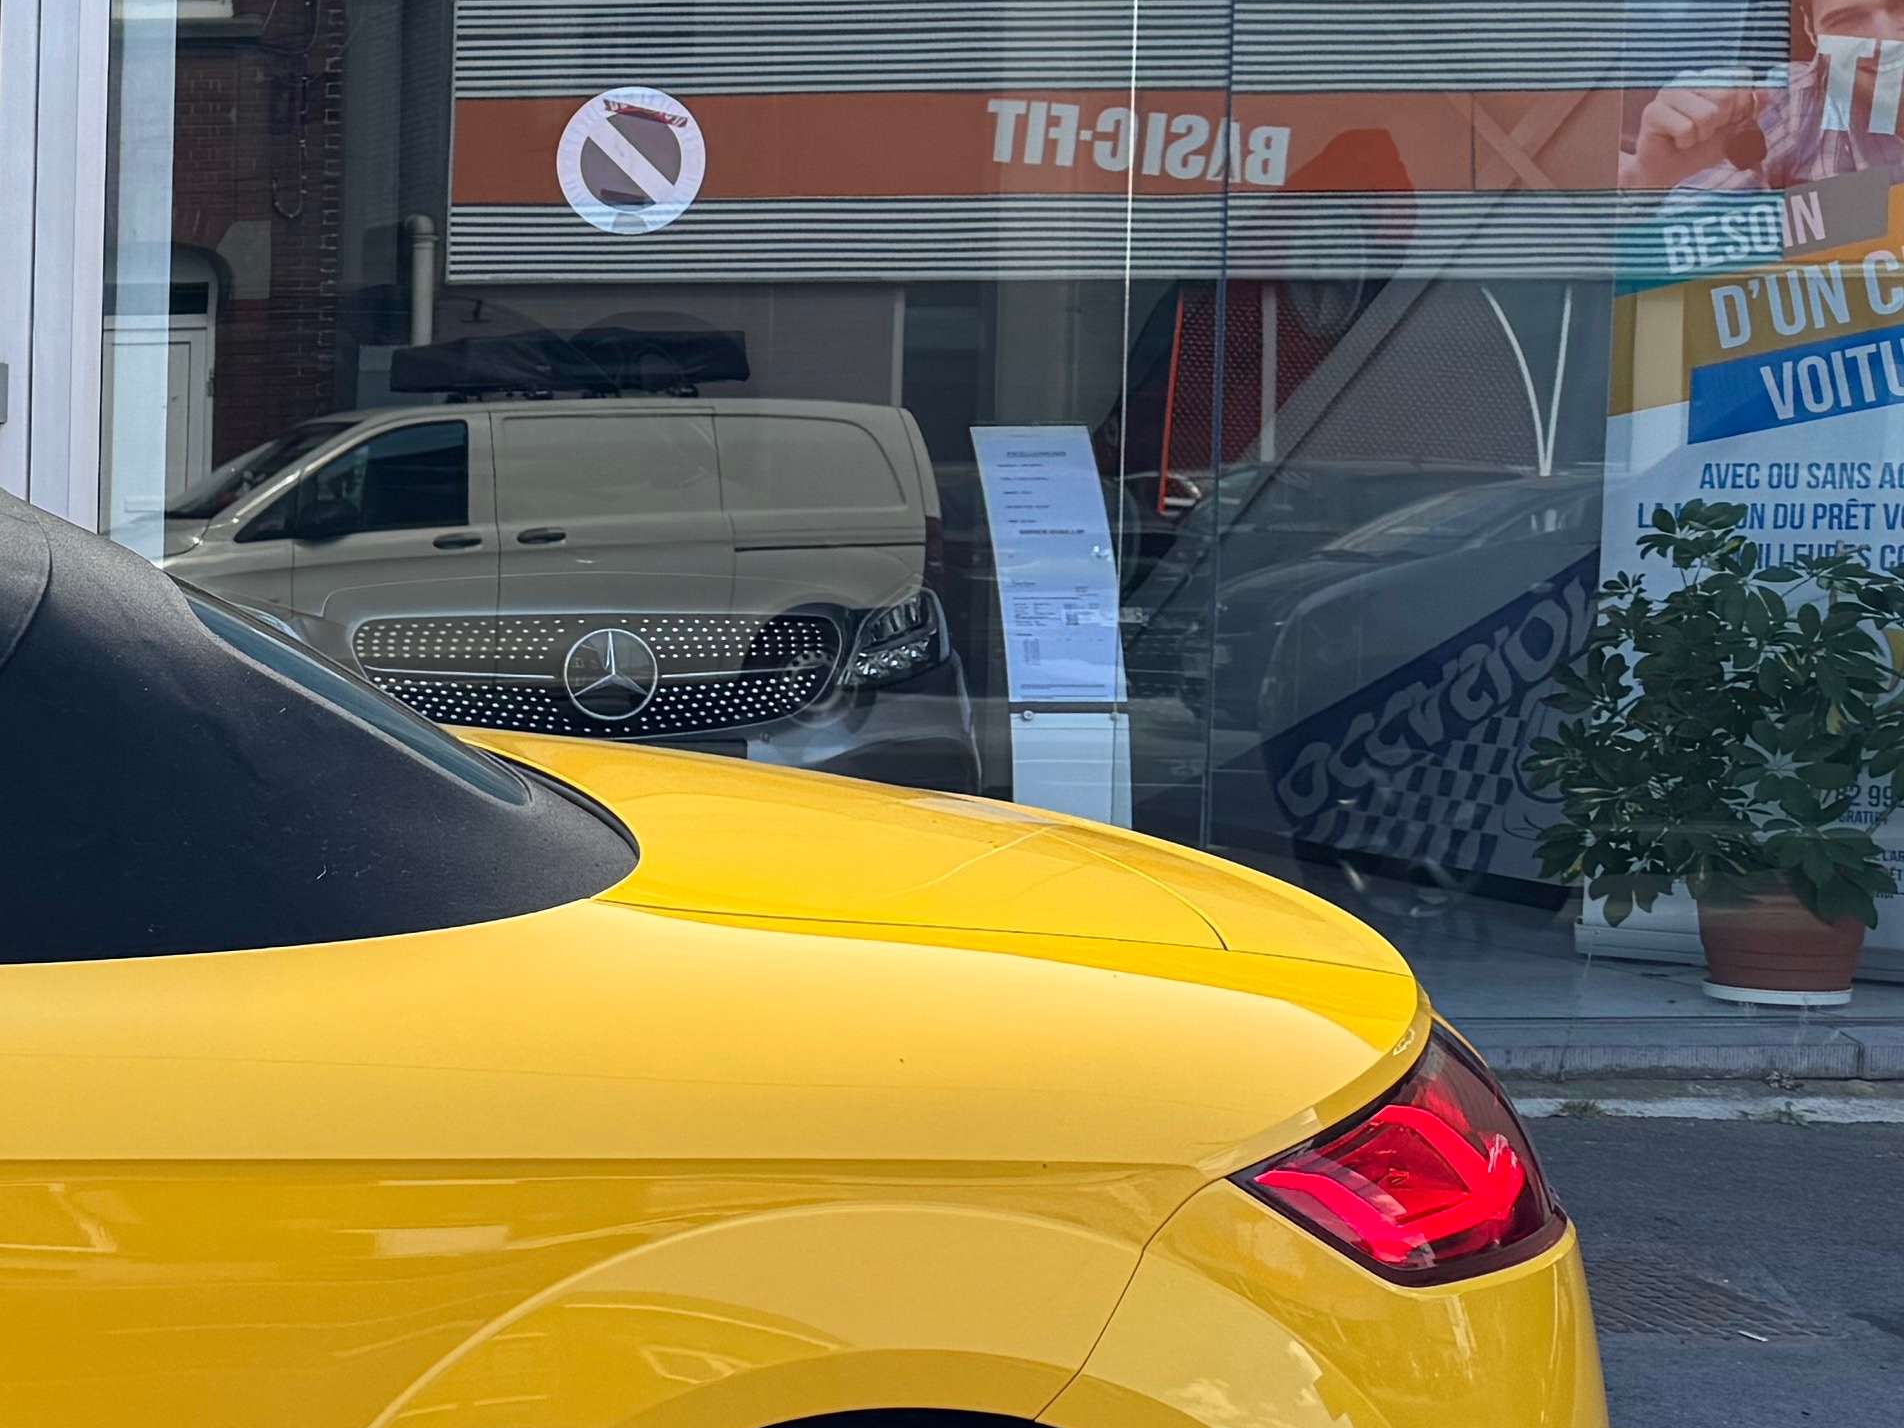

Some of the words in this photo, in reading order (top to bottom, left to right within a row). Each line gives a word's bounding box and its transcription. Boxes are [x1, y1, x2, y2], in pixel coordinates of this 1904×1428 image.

[1663, 191, 1826, 274] BESOIN
[1711, 261, 1851, 349] D'UN
[1700, 462, 1761, 490] AVEC
[1767, 462, 1800, 490] OU
[1806, 462, 1872, 490] SANS
[1638, 503, 1666, 529] L
[1773, 503, 1806, 530] DU
[1812, 498, 1876, 530] PRÊT
[1883, 503, 1904, 530] V
